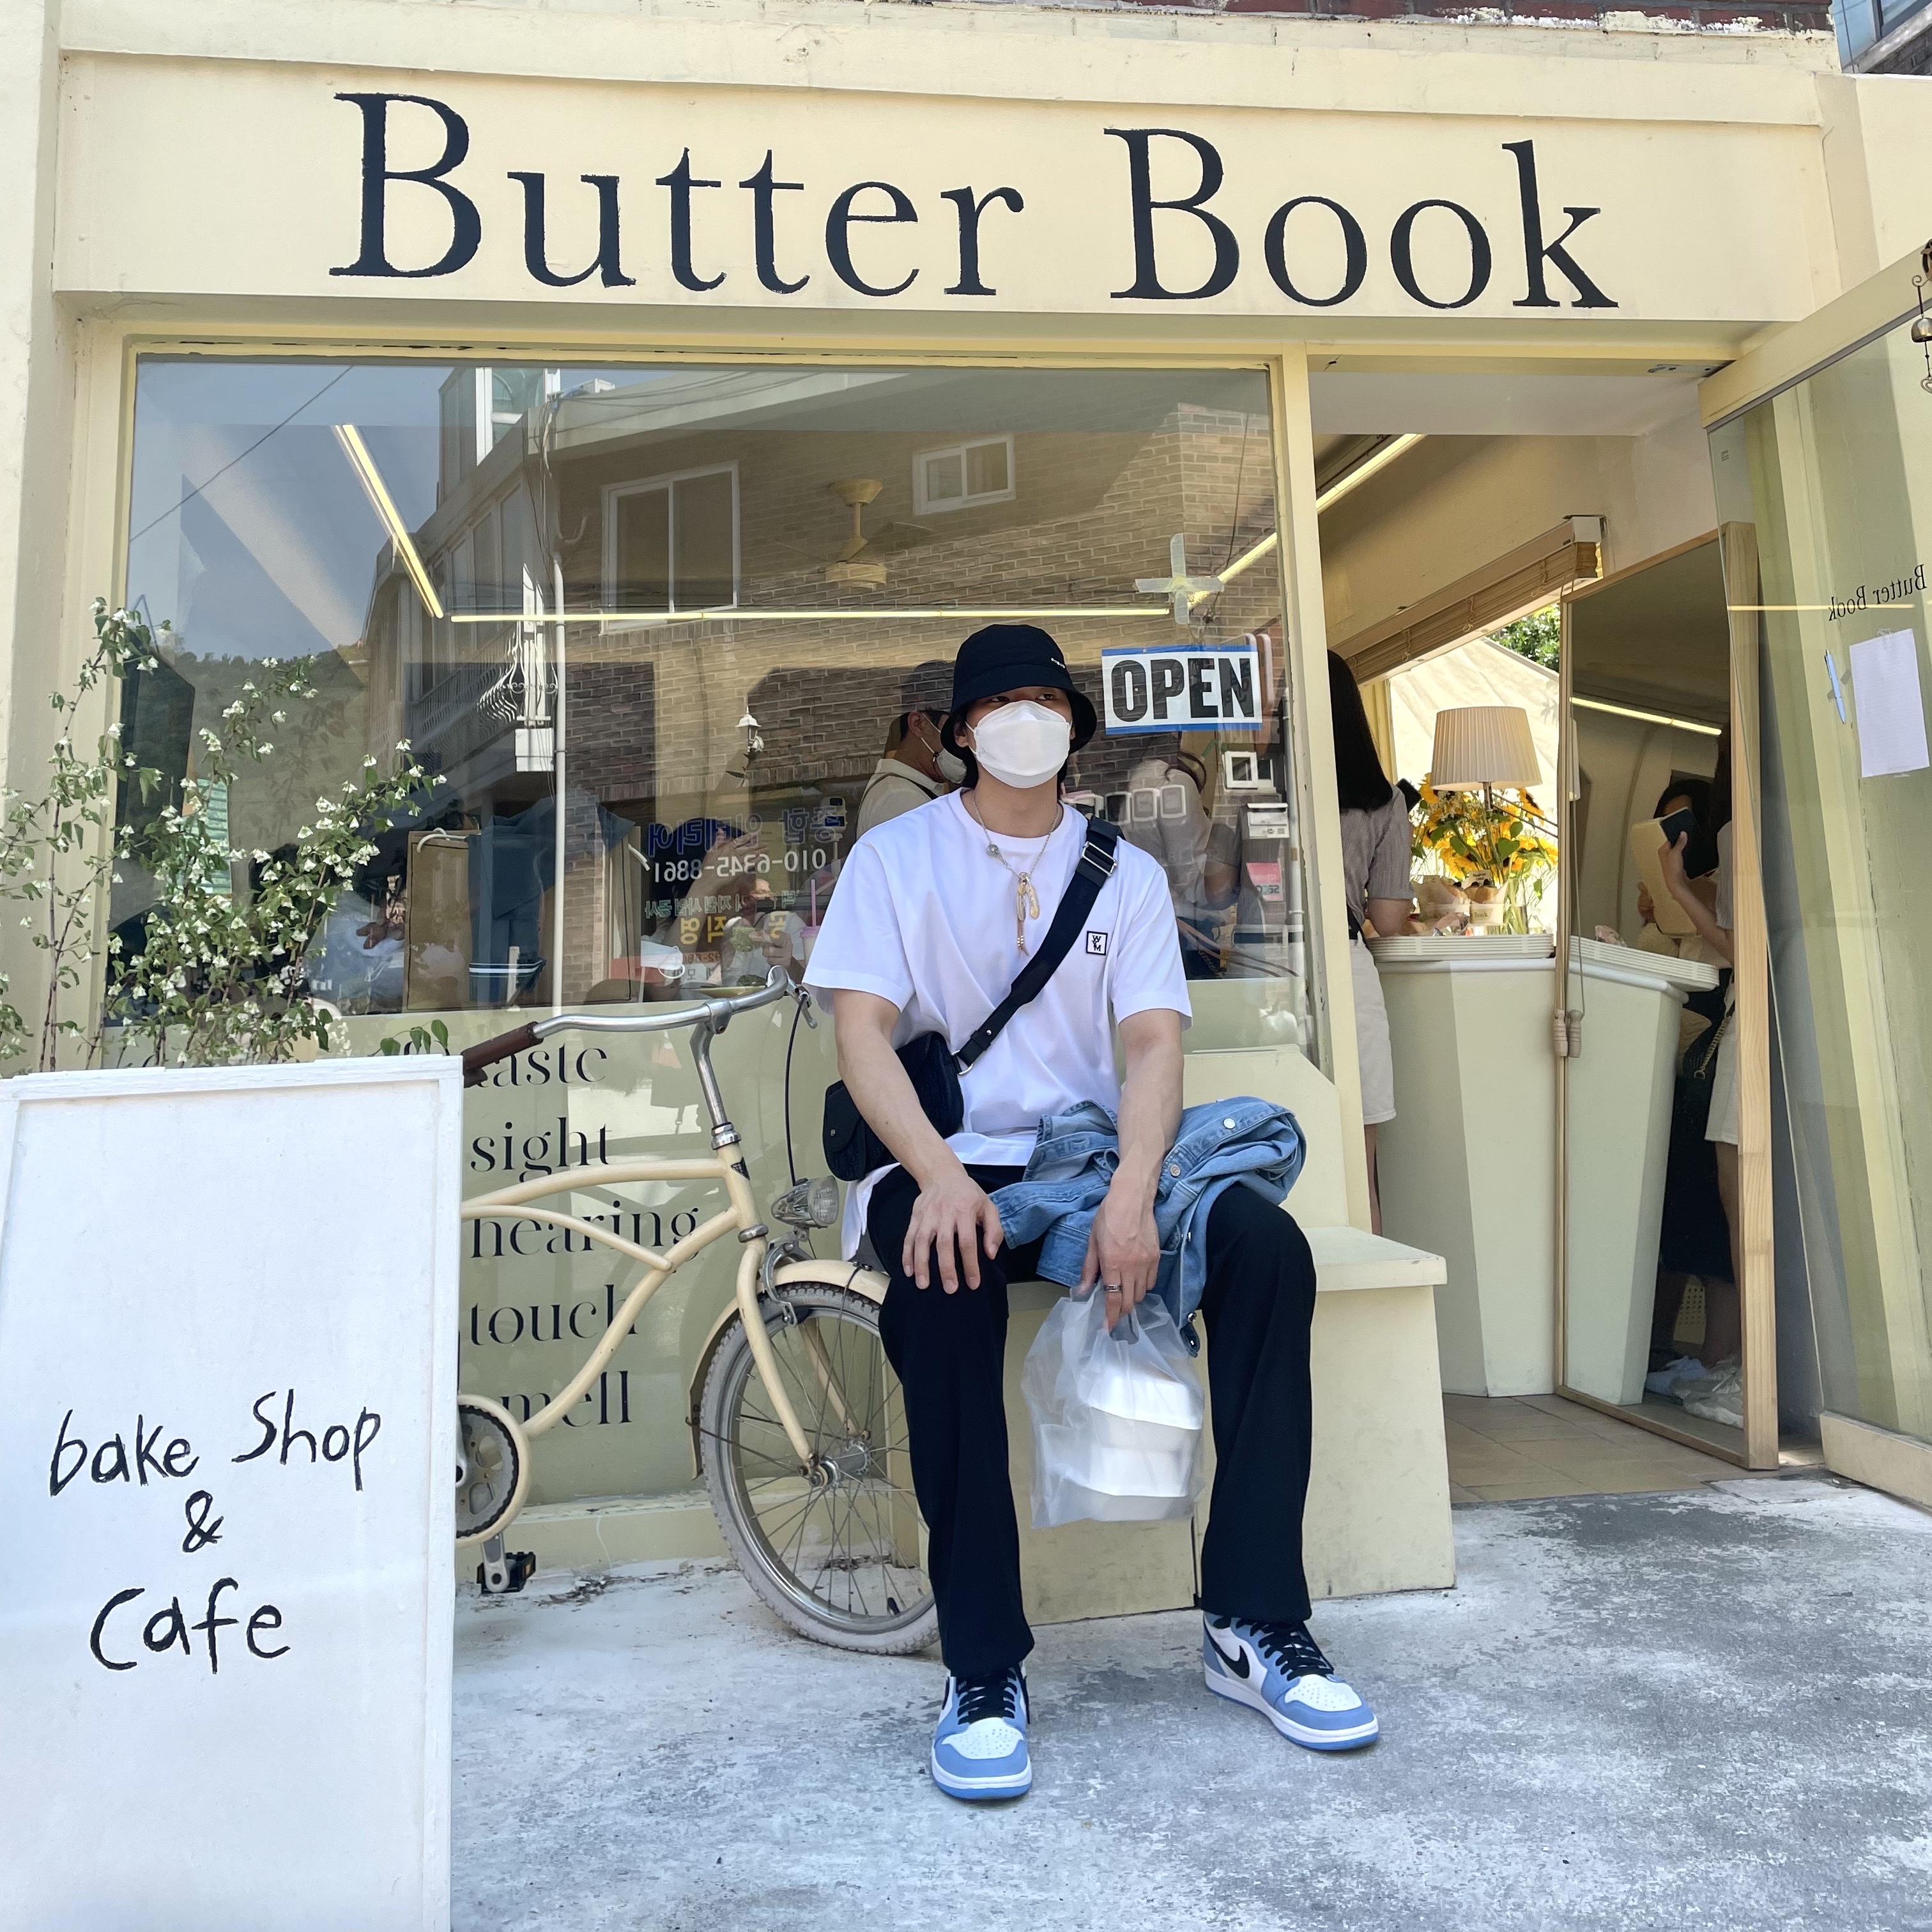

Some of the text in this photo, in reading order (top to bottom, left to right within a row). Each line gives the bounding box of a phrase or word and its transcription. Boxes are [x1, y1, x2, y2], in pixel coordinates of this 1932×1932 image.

[329, 93, 1619, 309] Butter Book
[1111, 658, 1254, 722] OPEN
[477, 1043, 607, 1088] aste
[470, 1117, 610, 1183] sight
[470, 1284, 638, 1346] touch
[50, 1409, 199, 1496] bake
[182, 1491, 224, 1552] &
[90, 1577, 291, 1675] Cafe
